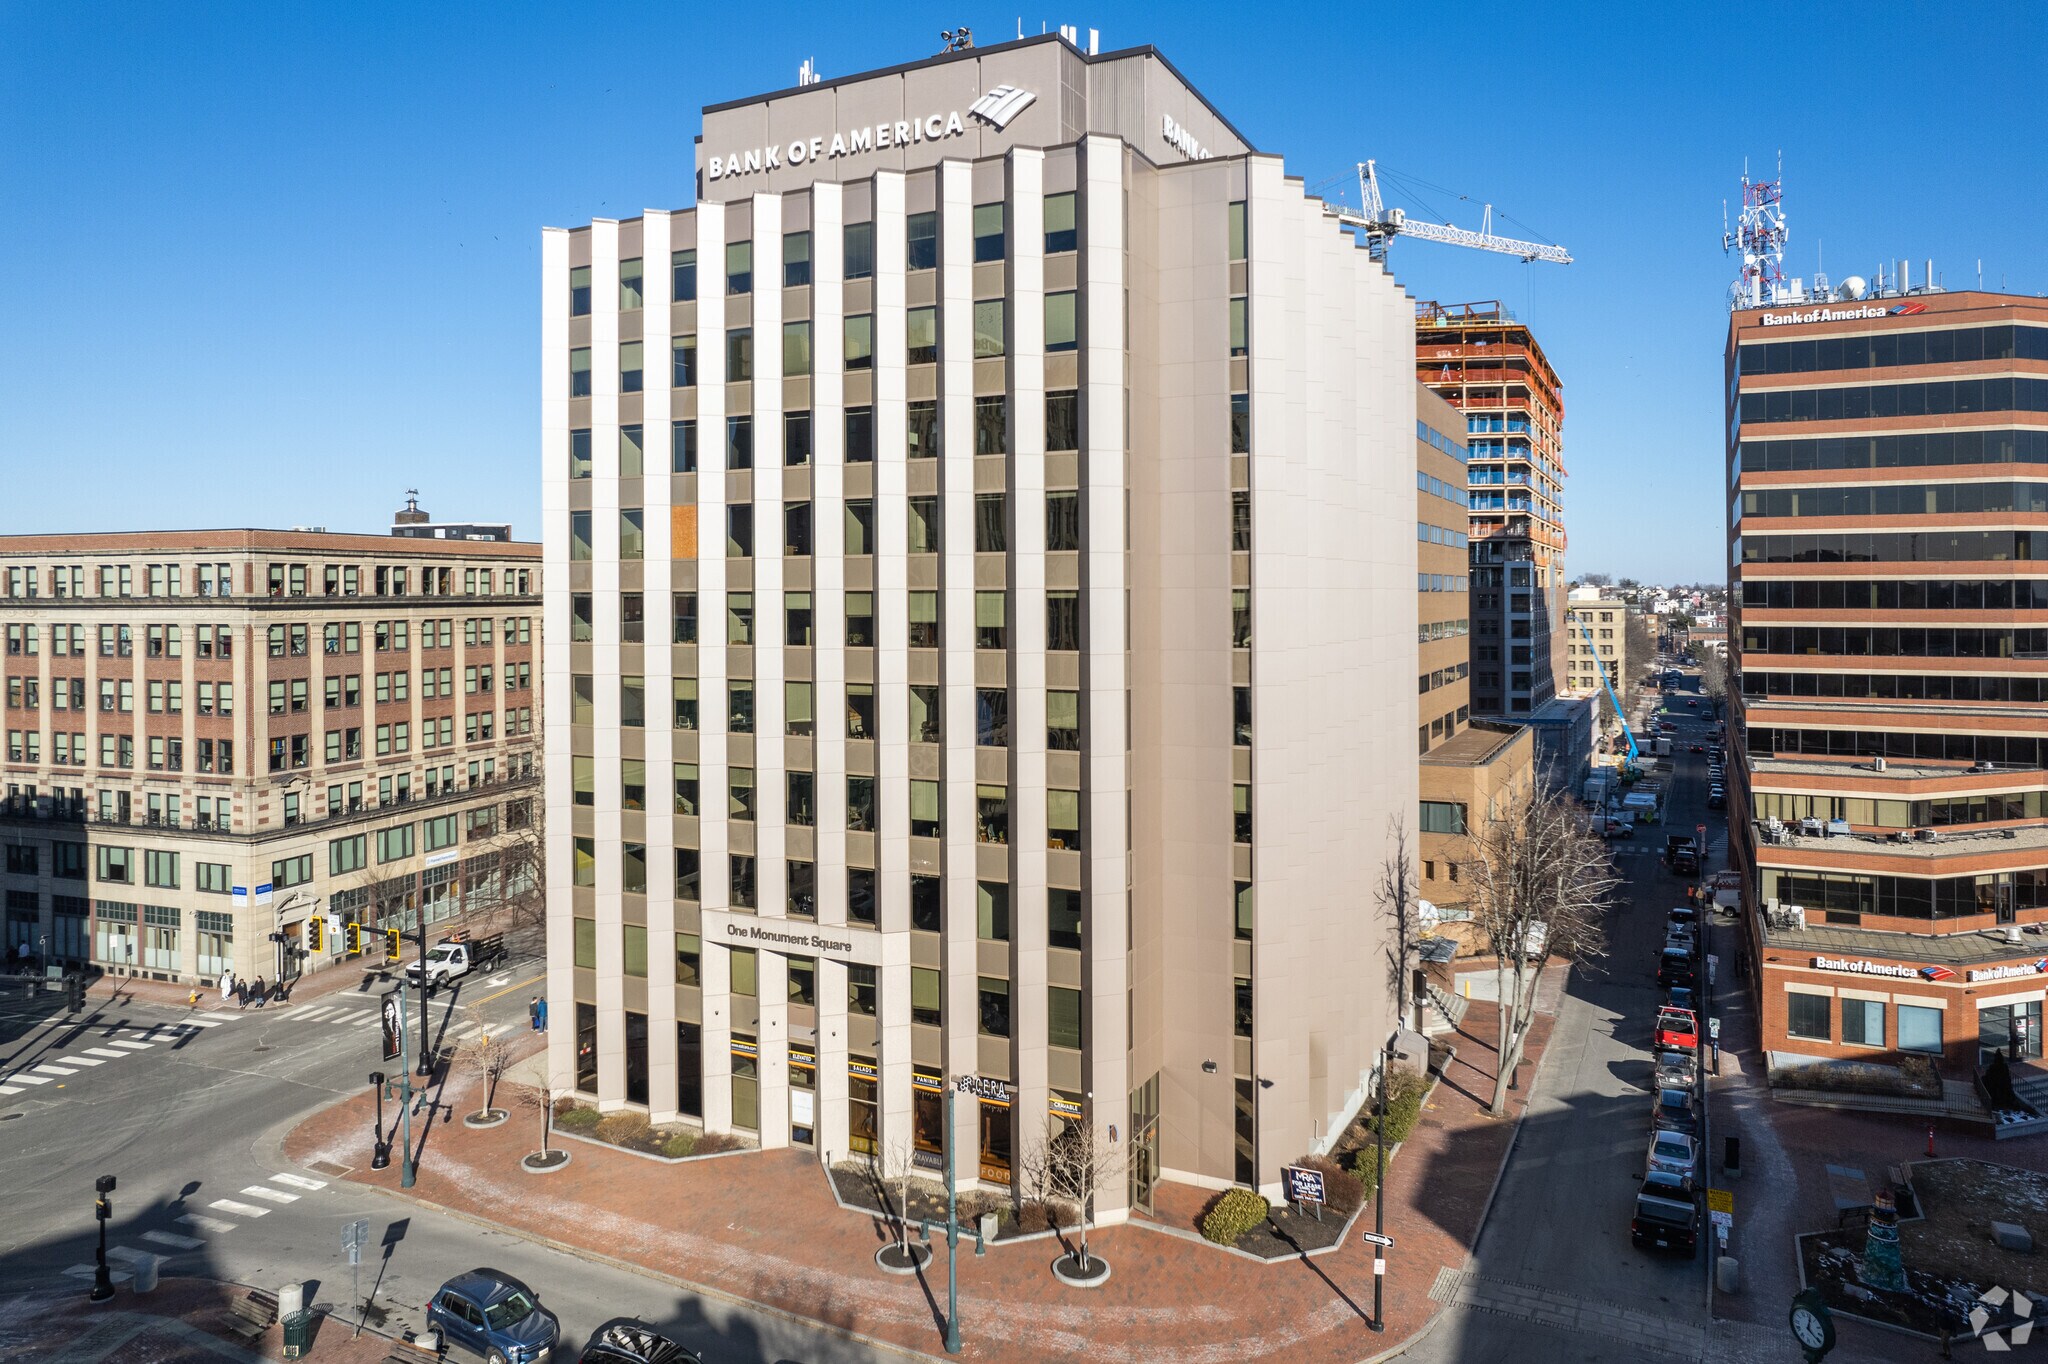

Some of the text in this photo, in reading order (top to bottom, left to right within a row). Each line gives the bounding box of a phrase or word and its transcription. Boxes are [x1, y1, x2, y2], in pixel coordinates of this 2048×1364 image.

[1163, 113, 1198, 160] BANK
[709, 111, 964, 178] BANK OF AMERICA
[727, 924, 852, 952] One Monument Square
[853, 1065, 872, 1074] SALADS
[916, 1076, 938, 1086] PANINIS
[976, 1077, 1005, 1096] CERA
[1295, 1171, 1316, 1183] MRA
[1304, 1182, 1322, 1190] LEASE
